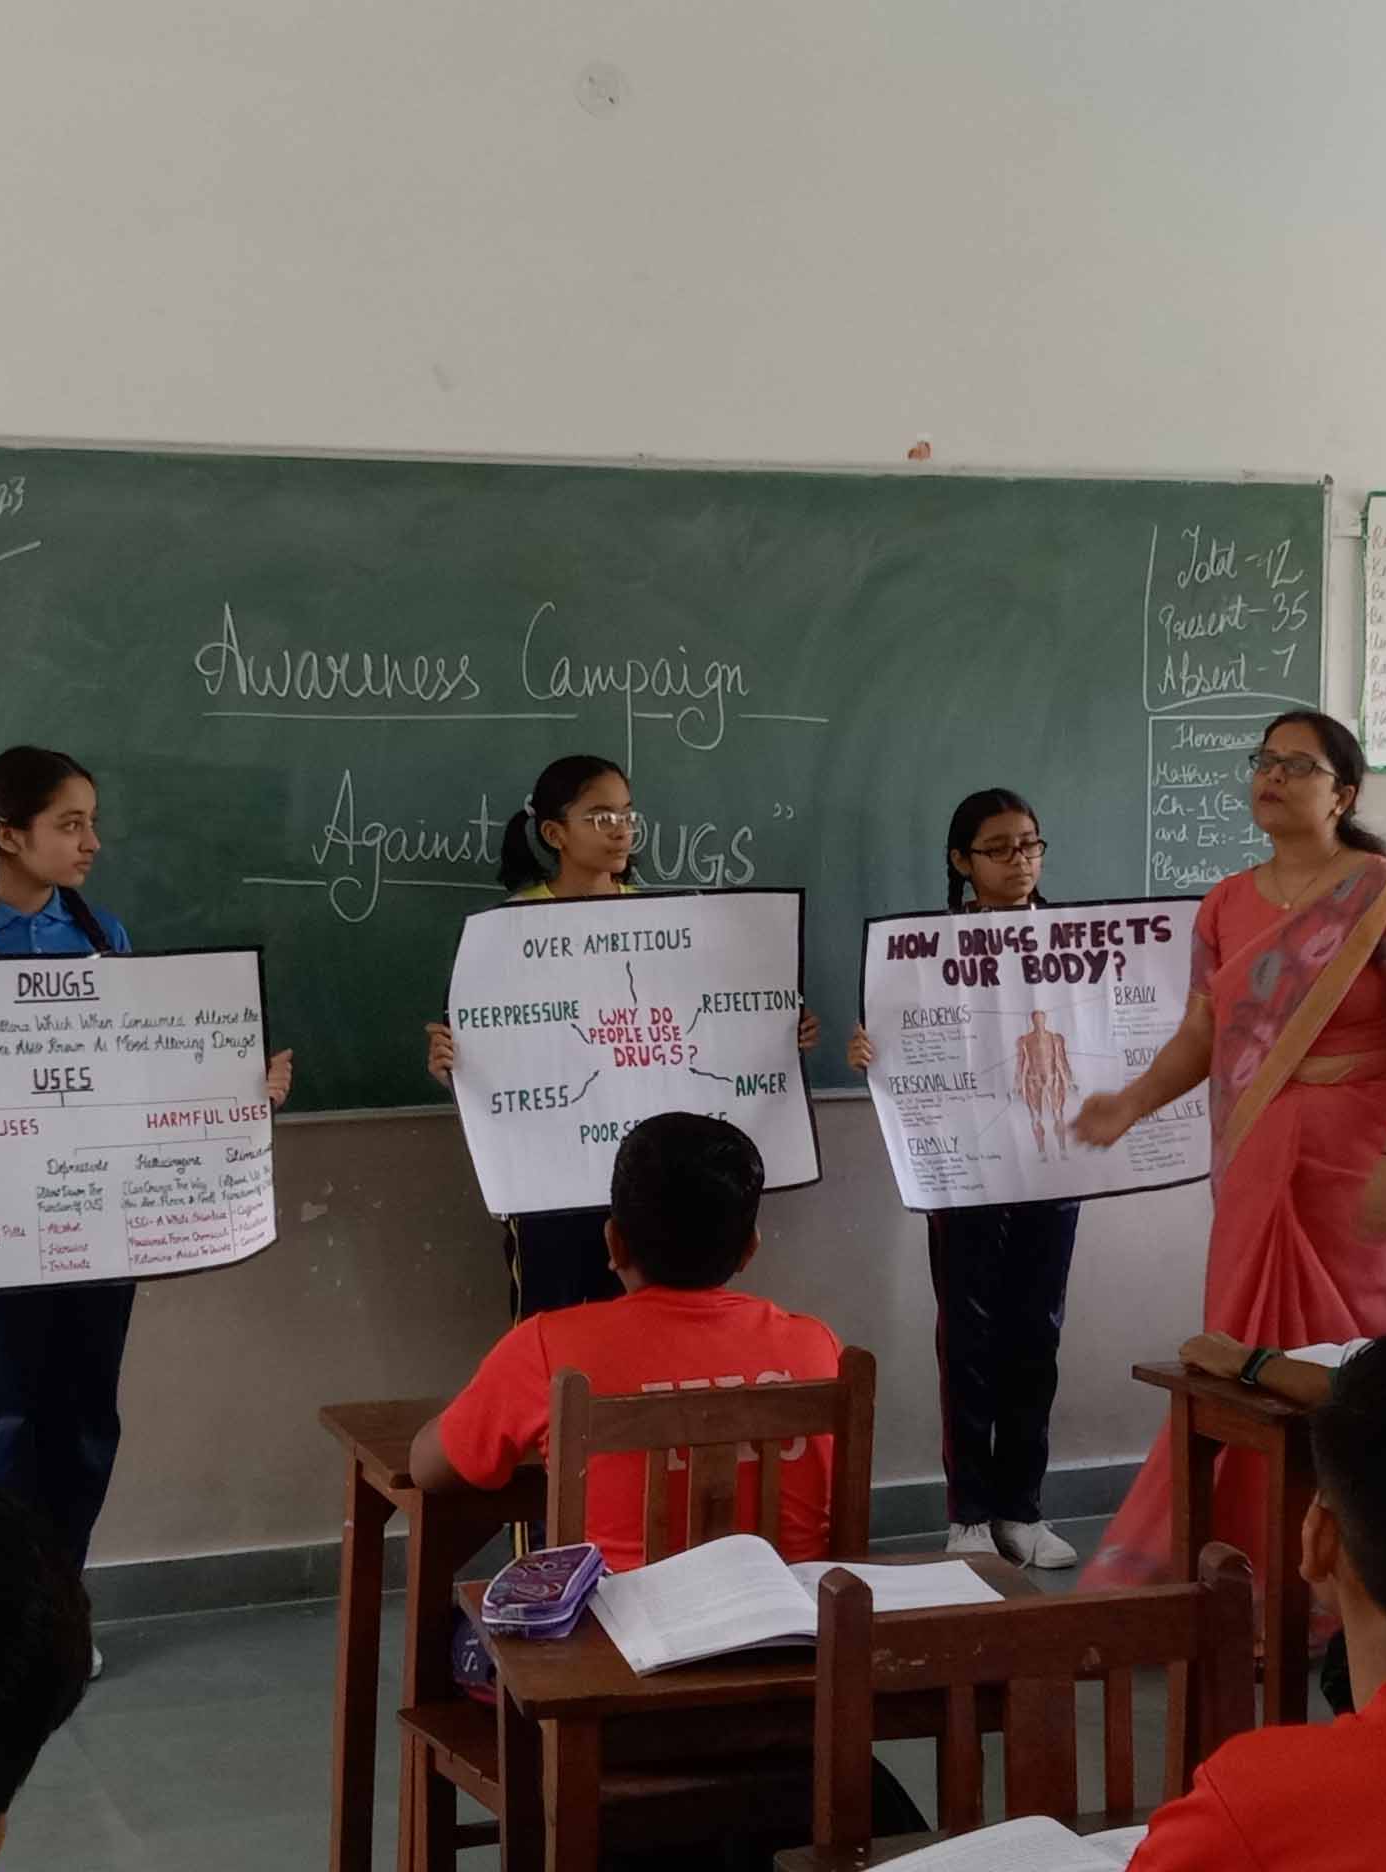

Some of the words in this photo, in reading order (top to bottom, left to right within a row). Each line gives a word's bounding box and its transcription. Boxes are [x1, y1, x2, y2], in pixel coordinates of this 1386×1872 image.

[1177, 523, 1238, 589] Total
[1158, 593, 1249, 646] Present
[1271, 590, 1310, 633] 35
[1158, 651, 1252, 698] Absent
[1270, 643, 1298, 679] 7
[194, 602, 481, 700] Awareness
[520, 602, 751, 780] Campaign
[1155, 823, 1189, 842] and
[312, 768, 505, 924] Against
[522, 937, 573, 960] OVER
[583, 927, 693, 956] AMBITIOUS
[886, 931, 940, 961] HOW
[957, 926, 1039, 957] DRUGS
[1049, 915, 1173, 951] AFFECTS
[941, 957, 1001, 988] OUR
[1021, 949, 1127, 985] BODY?
[17, 969, 98, 998] DRUGS
[1113, 985, 1157, 1006] BRAIN
[701, 988, 797, 1014] REJECTION
[598, 1007, 639, 1026] WHY
[650, 1006, 674, 1025] DO
[901, 1006, 972, 1029] ACADEMICS
[211, 1030, 257, 1059] Drugs
[588, 1026, 643, 1046] PEOPLE
[648, 1025, 683, 1044] USE
[32, 1066, 93, 1091] USES
[734, 1072, 788, 1098] ANGER
[887, 1072, 952, 1096] PERSONAL
[953, 1071, 978, 1091] LIFE
[490, 1084, 570, 1115] STRESS
[1173, 1099, 1206, 1120] LIFE
[145, 1108, 225, 1129] HARMFUL
[227, 1103, 269, 1123] USES
[579, 1122, 620, 1146] POOR
[906, 1135, 959, 1156] FAMILY
